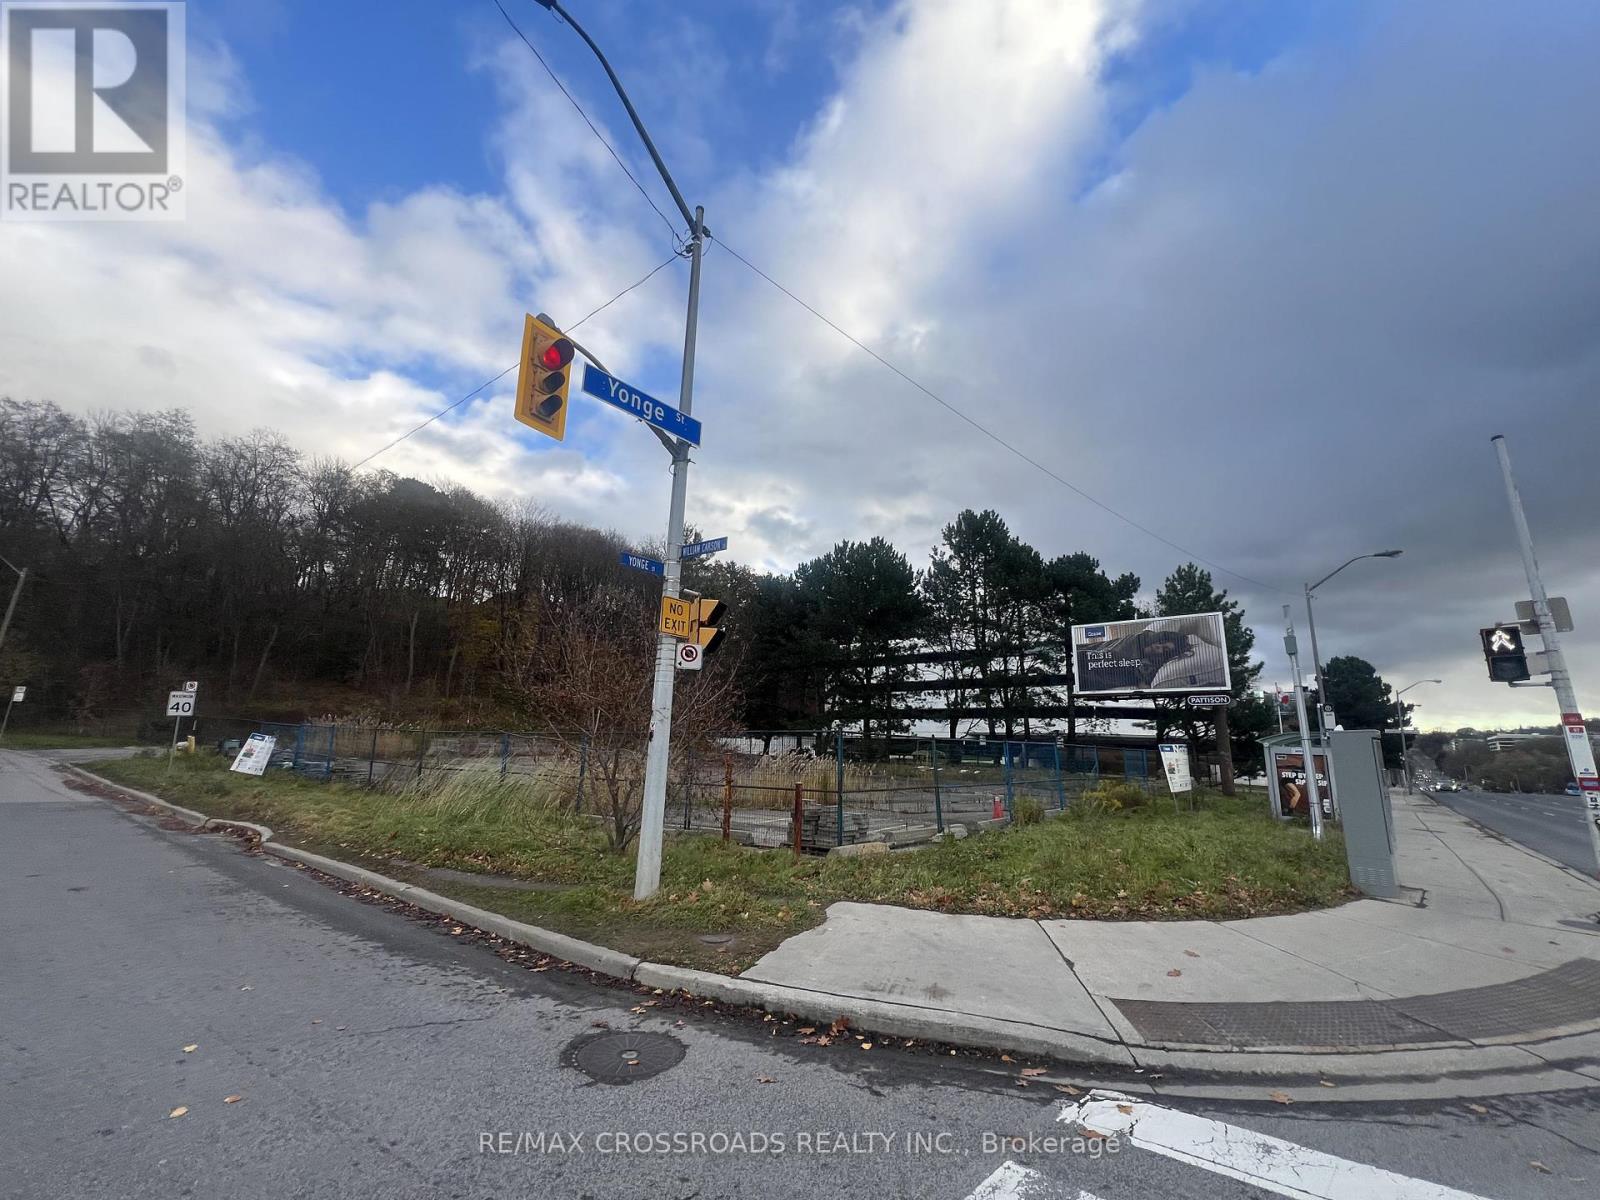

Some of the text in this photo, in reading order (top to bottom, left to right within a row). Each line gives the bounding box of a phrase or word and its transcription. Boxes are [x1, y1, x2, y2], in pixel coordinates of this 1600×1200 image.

[607, 377, 665, 422] Yonge
[683, 545, 701, 557] WILLIAM
[701, 539, 721, 553] CARSON
[628, 555, 649, 570] YONGE
[669, 602, 683, 616] NO
[664, 617, 687, 633] EXIT
[1087, 651, 1112, 660] This is
[1088, 659, 1118, 671] perfect
[170, 702, 191, 713] 40
